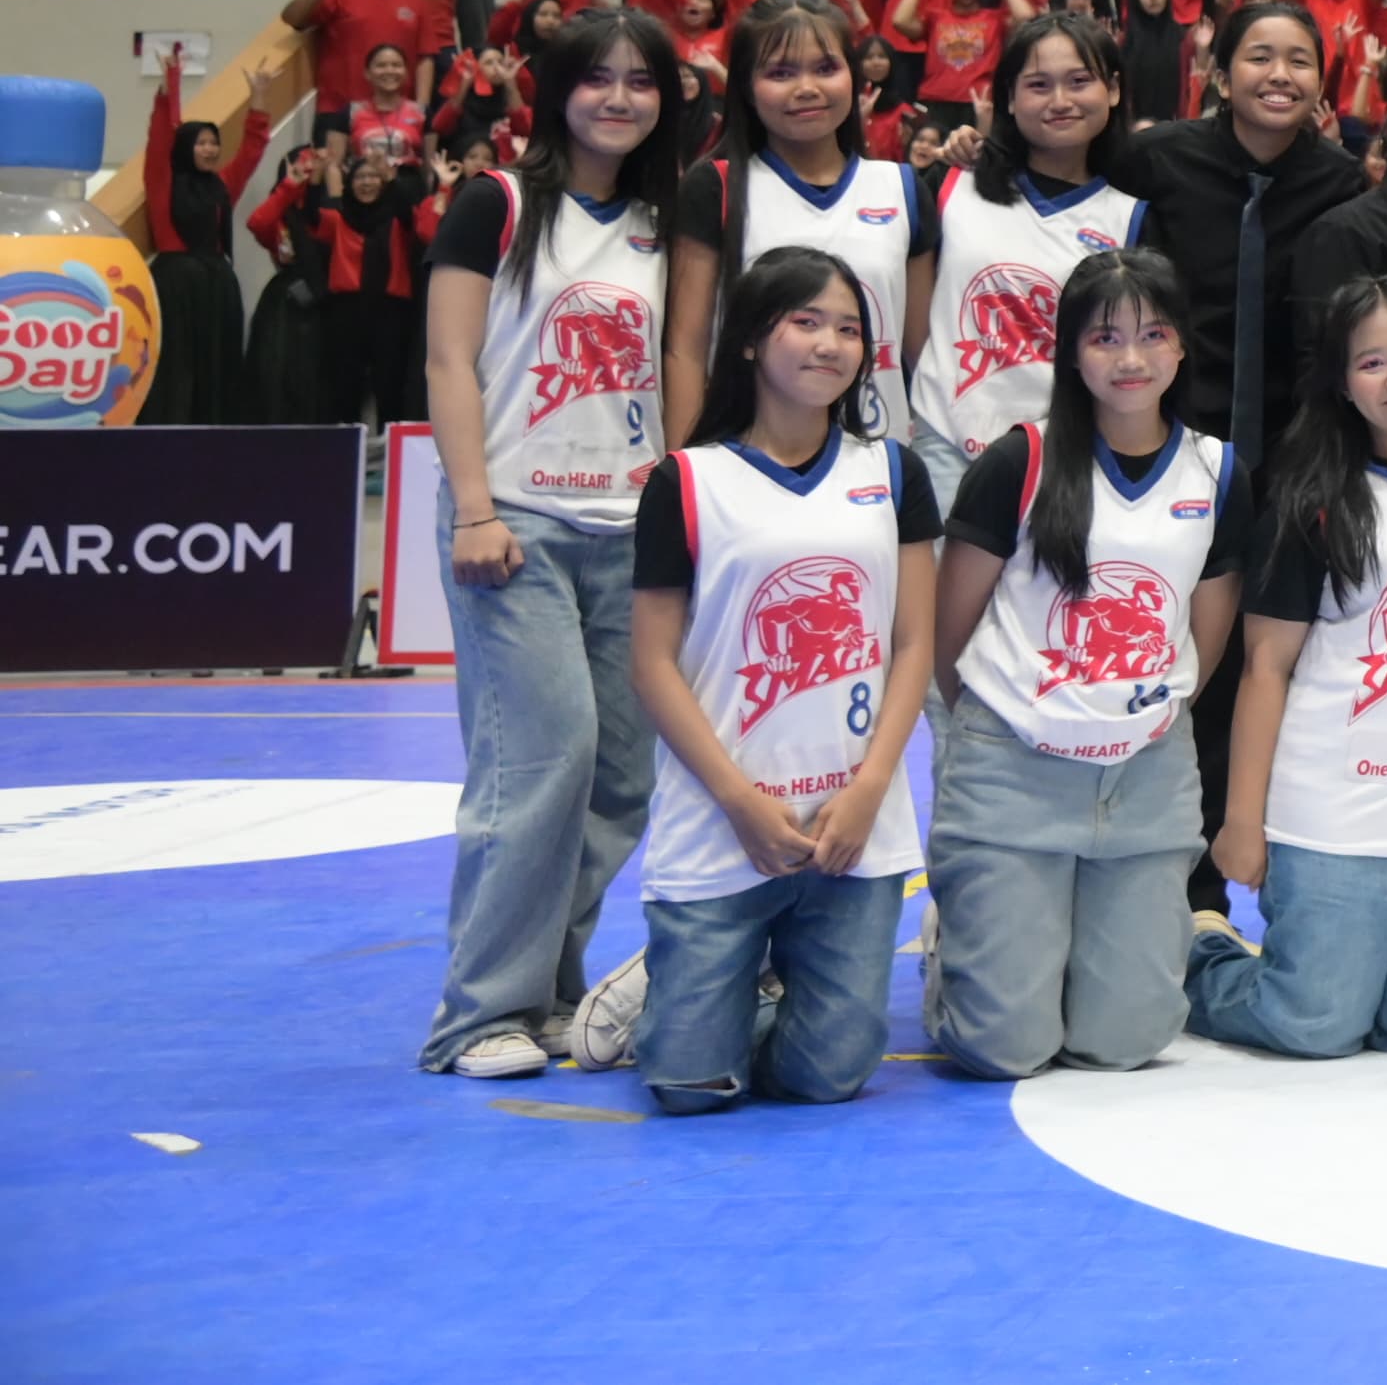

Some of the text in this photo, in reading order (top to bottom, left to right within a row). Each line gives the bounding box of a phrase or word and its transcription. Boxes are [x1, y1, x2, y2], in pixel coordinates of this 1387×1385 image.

[627, 399, 645, 446] 9
[531, 470, 566, 487] One
[847, 681, 872, 737] 8
[1074, 741, 1131, 757] HEART.
[791, 772, 848, 796] HEART.
